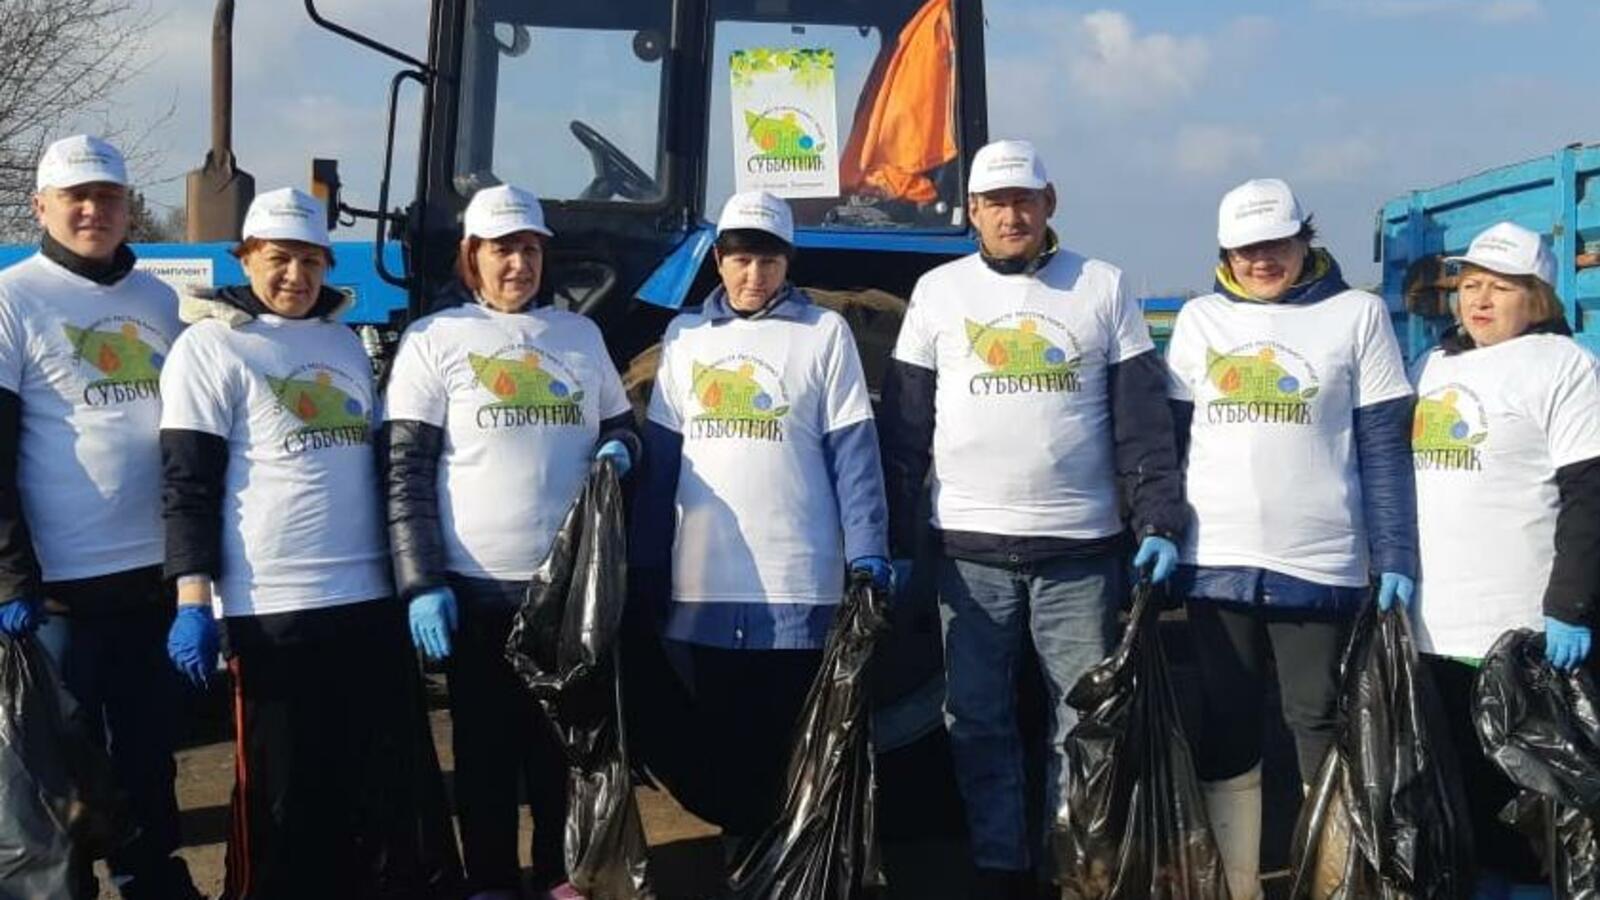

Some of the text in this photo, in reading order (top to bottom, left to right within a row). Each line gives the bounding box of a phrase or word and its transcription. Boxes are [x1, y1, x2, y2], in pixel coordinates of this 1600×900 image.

[747, 155, 825, 173] СУББОТНИК
[969, 372, 1083, 395] СУББОТНИК
[476, 404, 586, 429] СУББОТНИК
[1207, 400, 1313, 425] СУББОТНИК
[690, 418, 783, 442] СУББОТНИК
